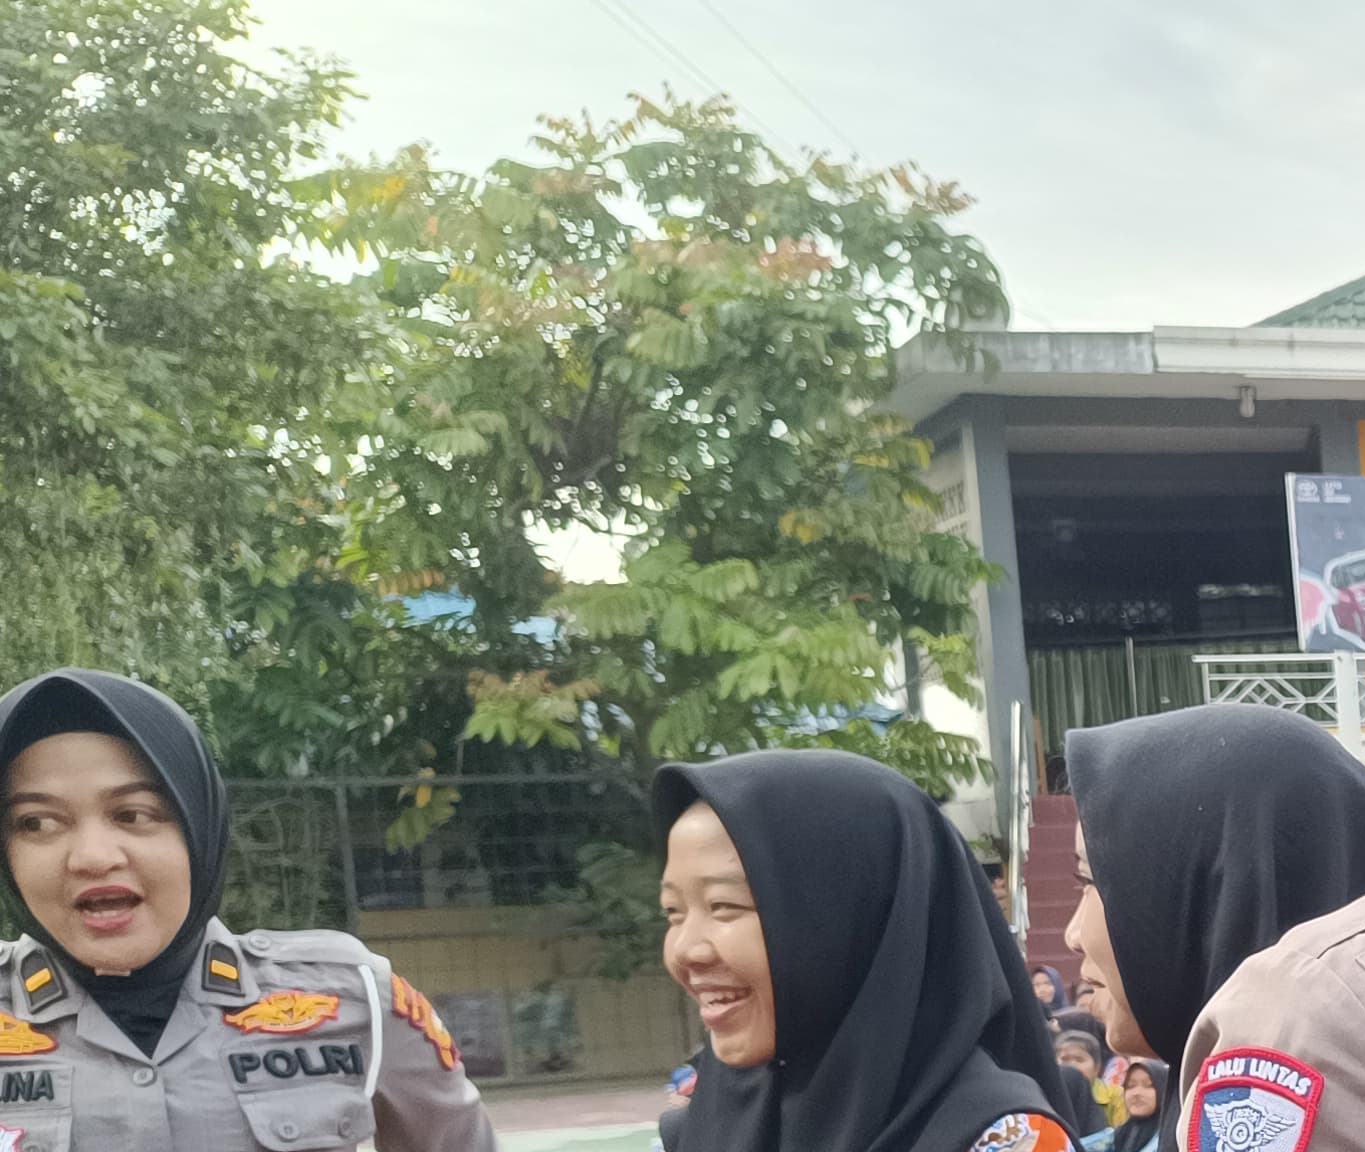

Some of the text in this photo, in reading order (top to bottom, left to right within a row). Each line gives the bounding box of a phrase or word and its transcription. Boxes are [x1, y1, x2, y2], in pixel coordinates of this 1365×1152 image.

[228, 1044, 364, 1084] POLRI
[1207, 1057, 1313, 1096] LALU LINTAS
[0, 1070, 55, 1102] INA
